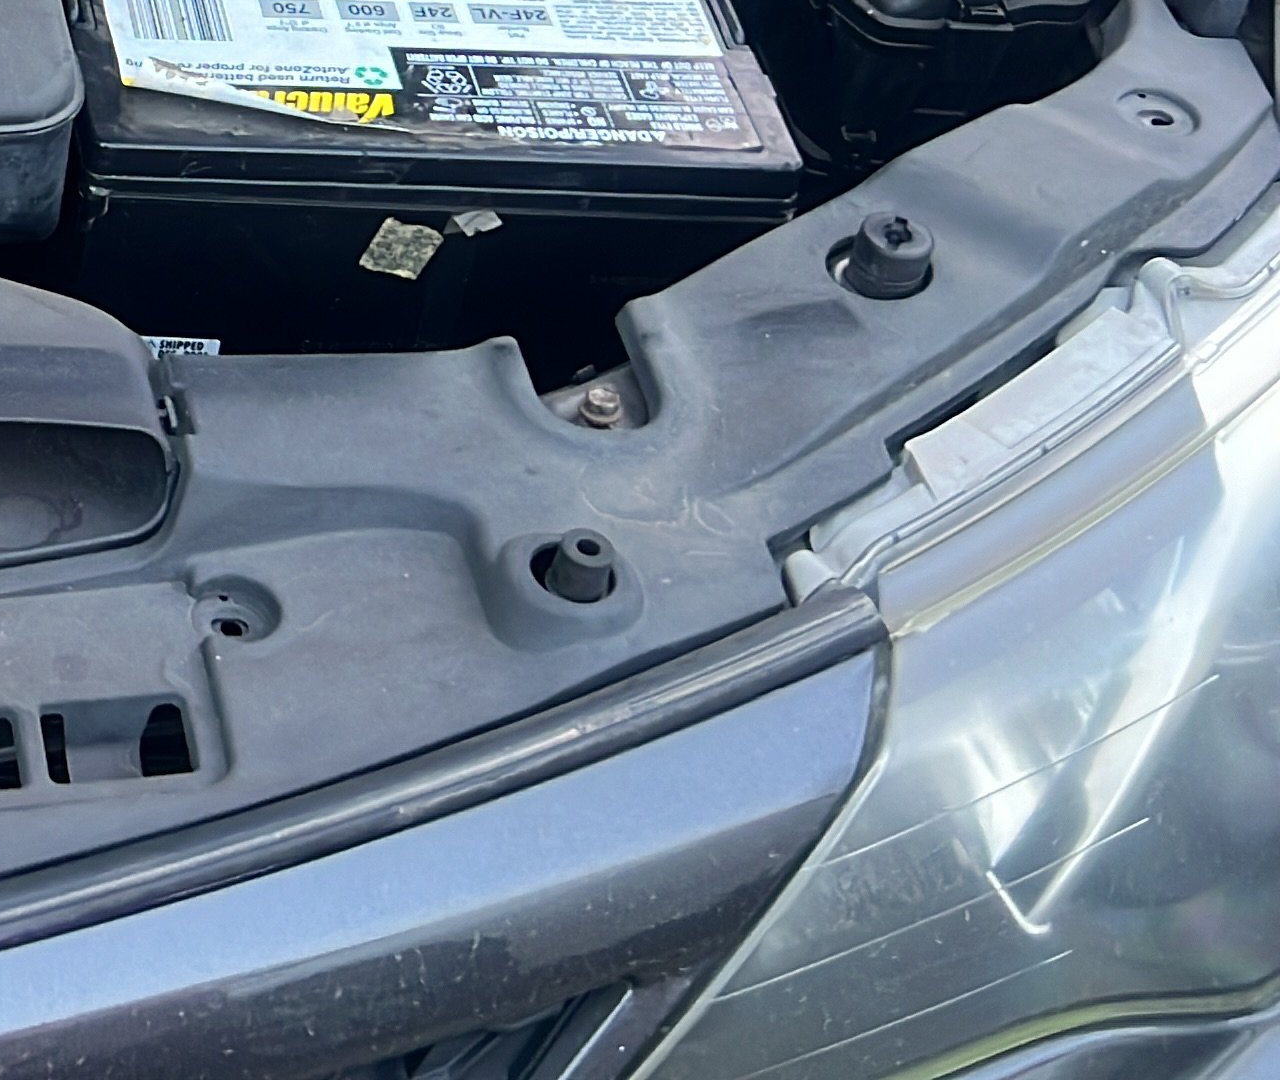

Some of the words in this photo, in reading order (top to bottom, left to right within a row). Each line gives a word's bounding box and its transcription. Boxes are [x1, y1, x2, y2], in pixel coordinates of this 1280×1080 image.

[272, 2, 311, 15] 750
[348, 4, 385, 16] 600
[414, 6, 453, 18] 24F
[471, 8, 547, 21] 24F-VL
[197, 62, 245, 72] proper
[249, 64, 270, 74] for
[274, 65, 350, 75] AutoZone
[259, 73, 295, 84] used
[299, 74, 351, 85] Return
[497, 126, 654, 142] DANGER/POISON
[159, 339, 204, 351] SHIPPED
